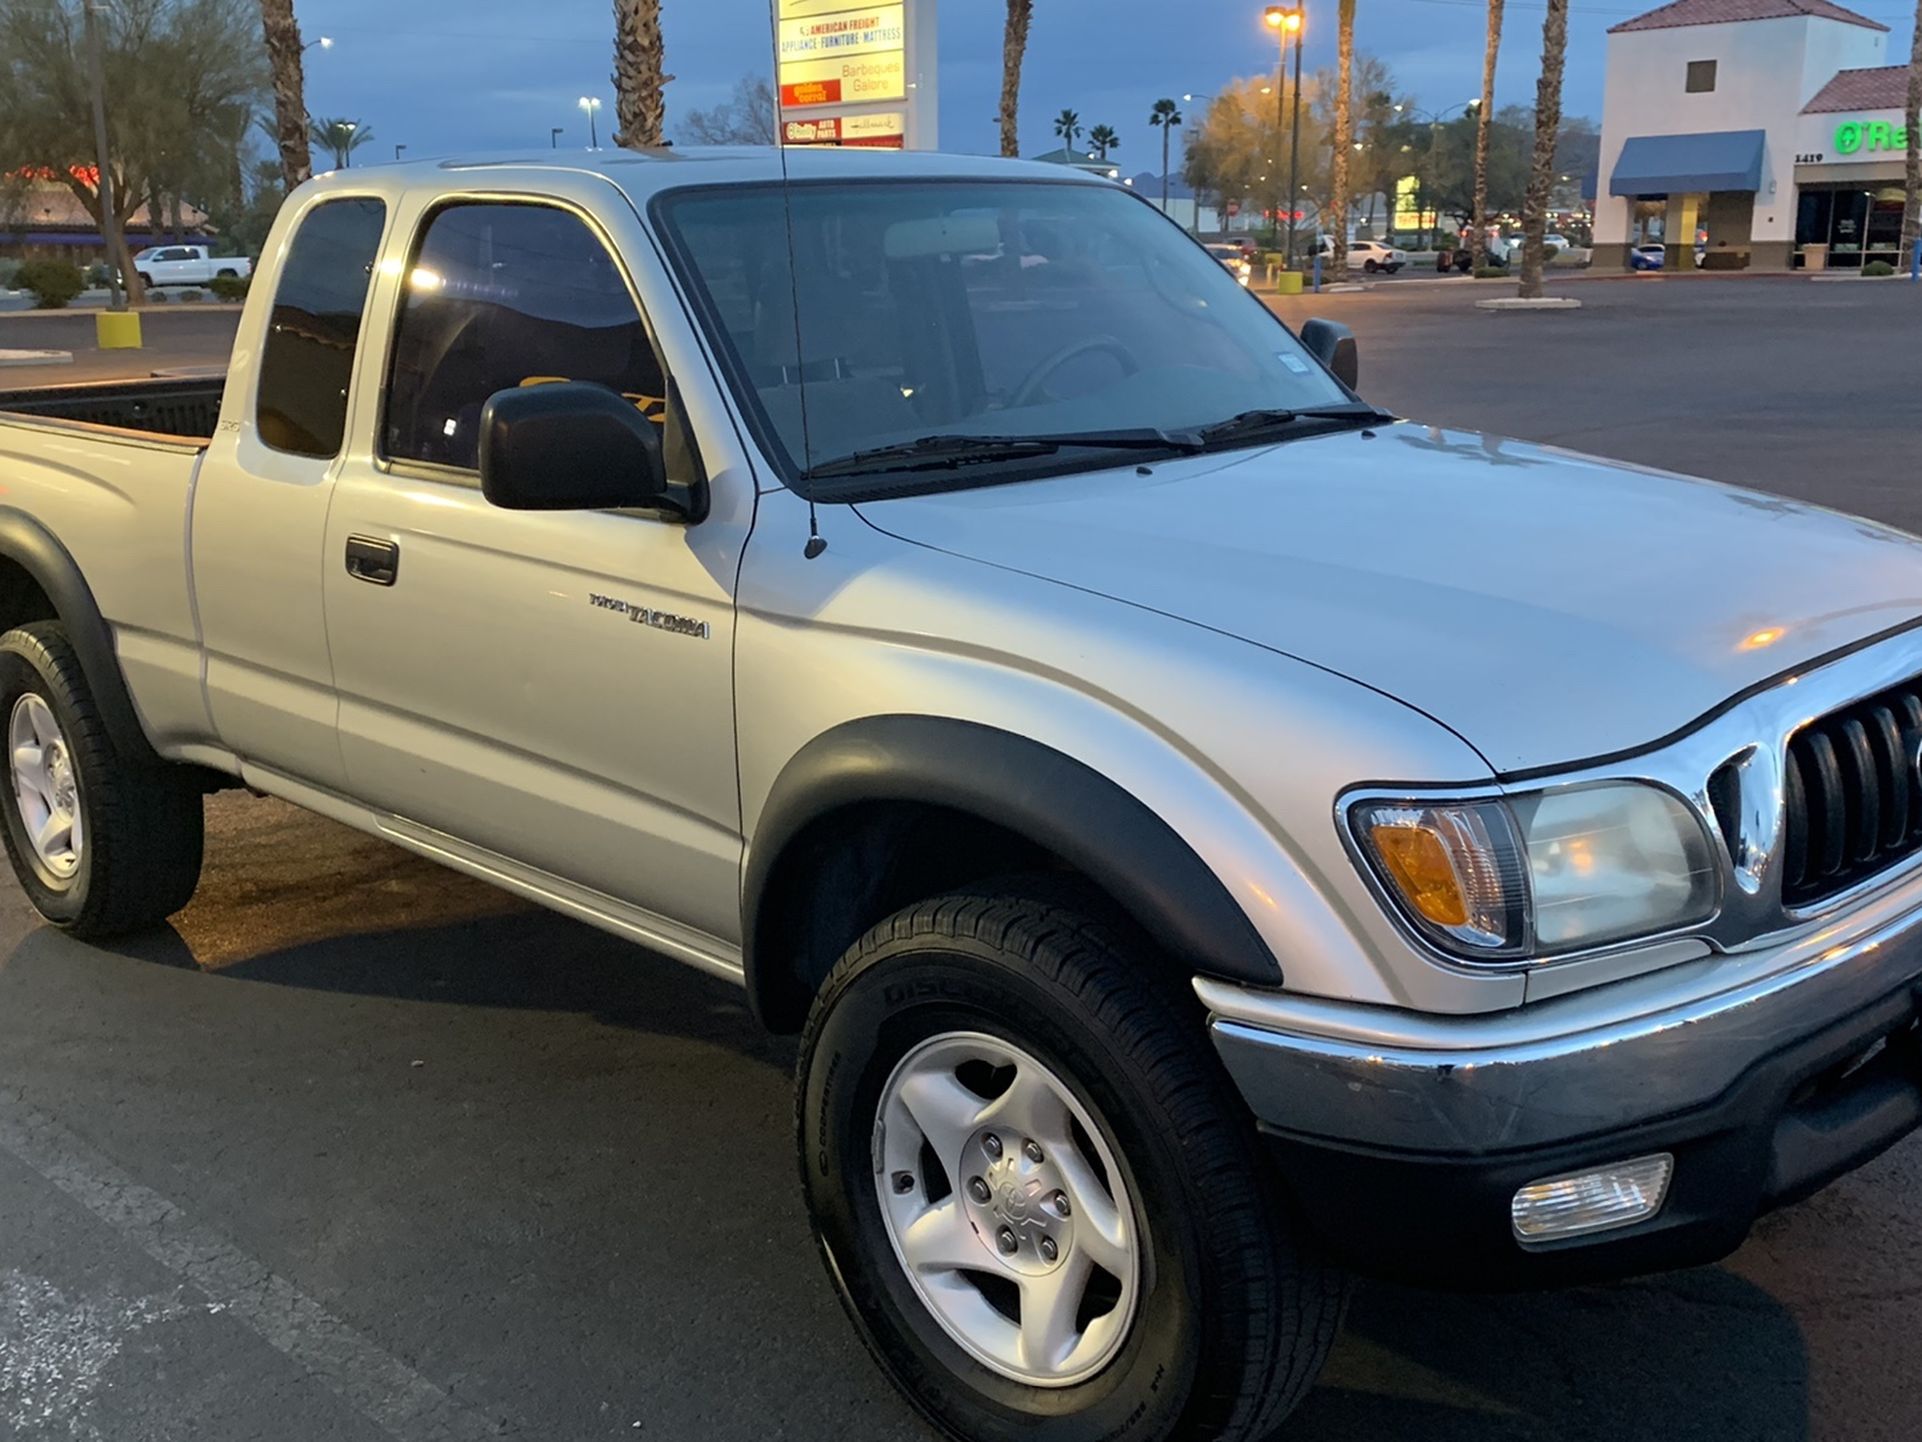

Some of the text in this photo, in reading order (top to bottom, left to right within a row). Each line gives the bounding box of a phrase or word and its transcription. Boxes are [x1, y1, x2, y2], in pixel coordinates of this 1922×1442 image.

[810, 16, 880, 35] AMERICAN FREIGHT
[781, 27, 901, 52] APPLIANCE FURNITURE MATTRESS
[853, 79, 889, 92] Galore
[818, 120, 835, 129] AUTO
[817, 128, 836, 138] PARTS
[1795, 153, 1823, 163] 1419
[629, 605, 709, 640] TACOMA
